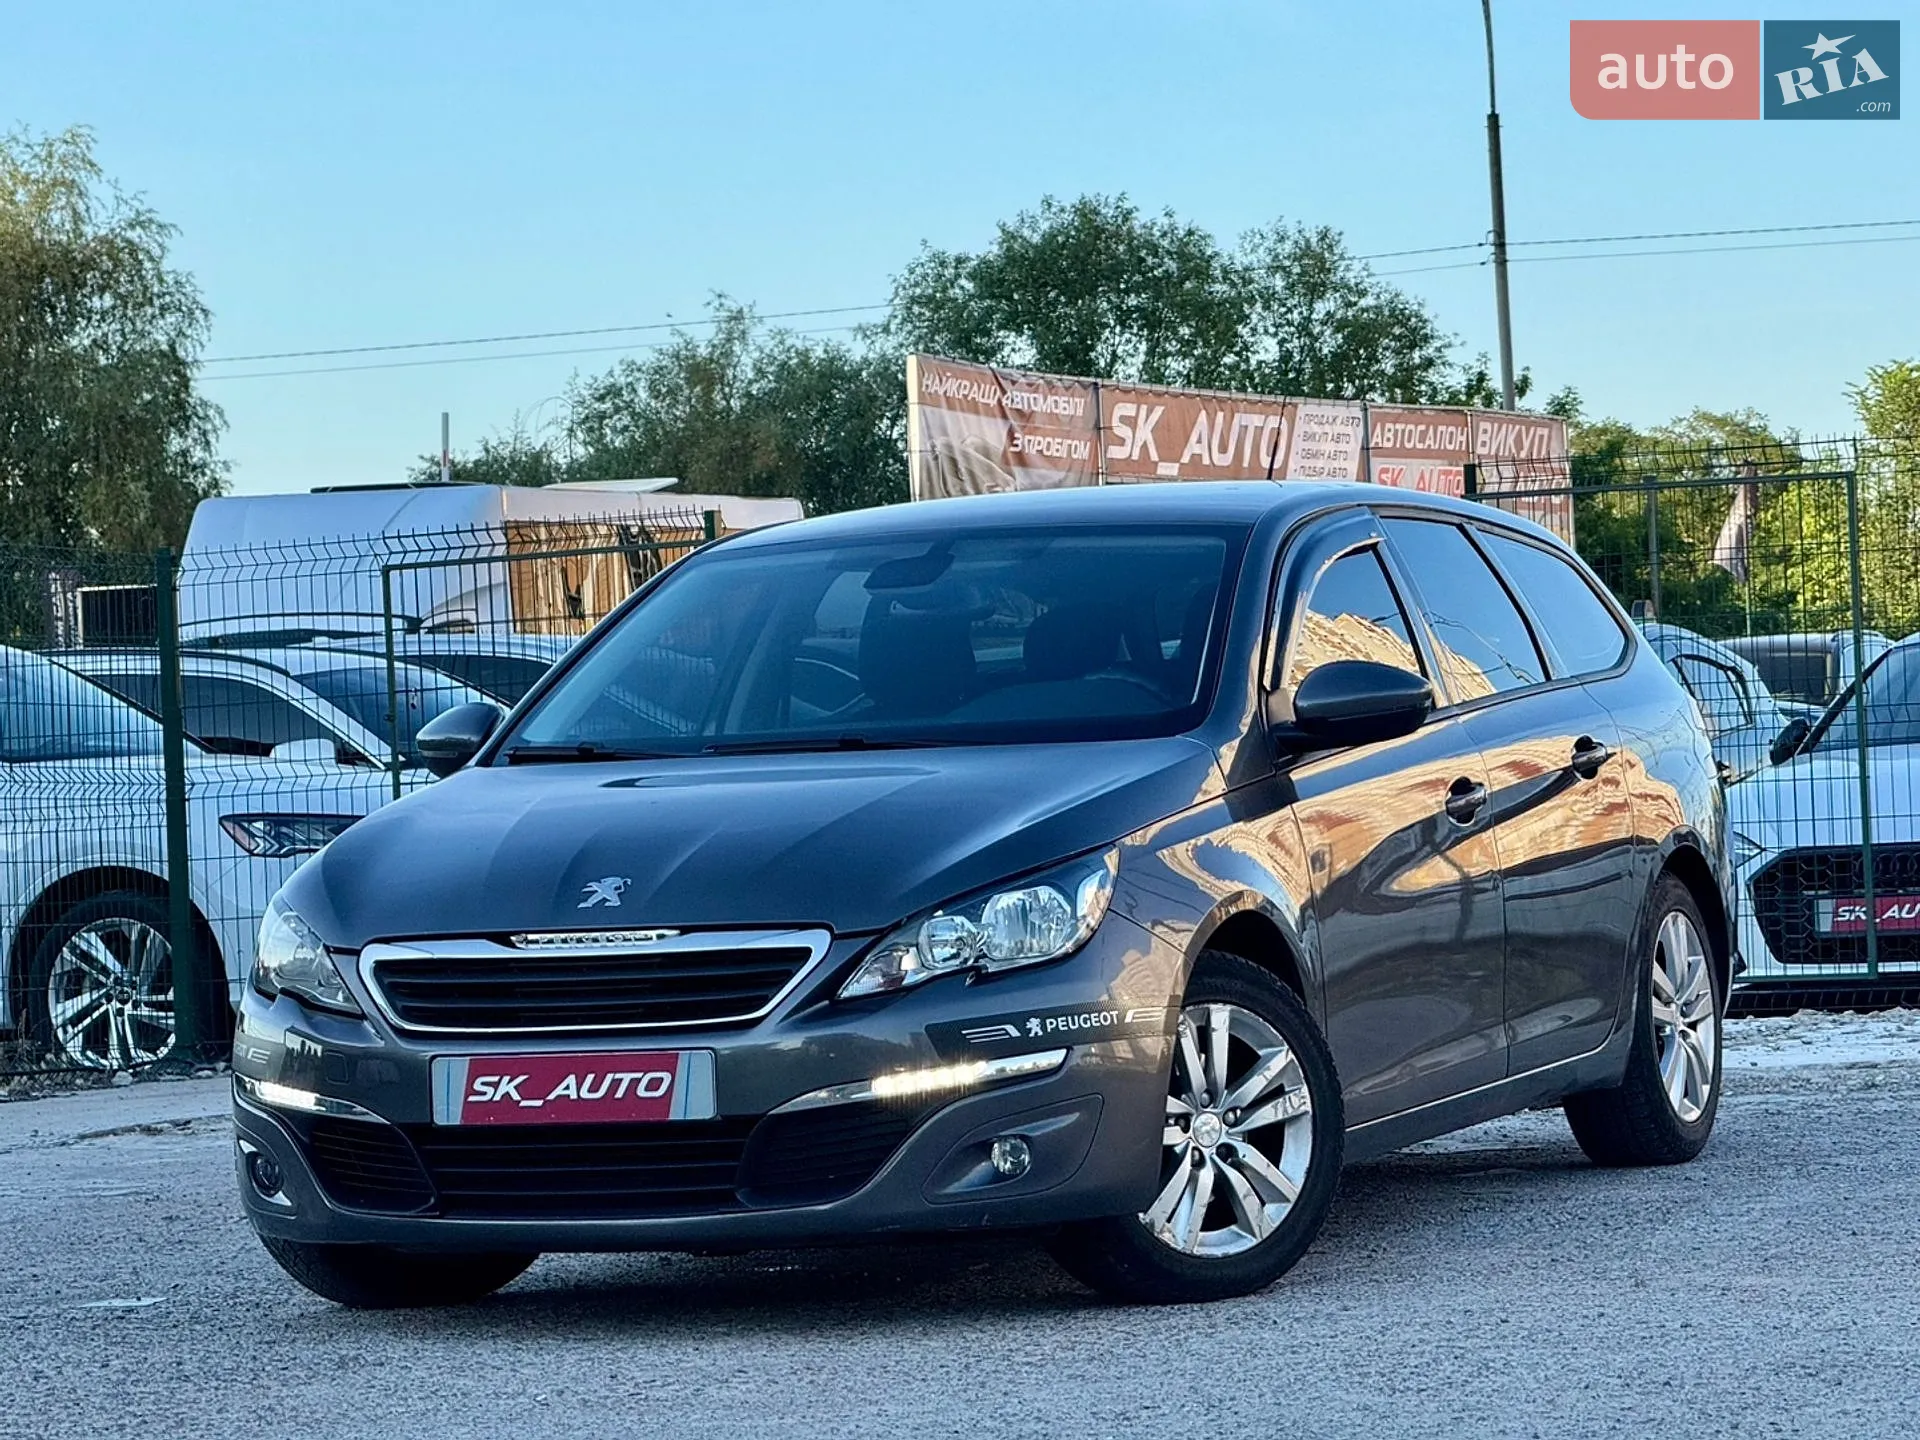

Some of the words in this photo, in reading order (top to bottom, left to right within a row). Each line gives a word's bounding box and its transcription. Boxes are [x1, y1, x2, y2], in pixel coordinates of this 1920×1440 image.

[1340, 416, 1361, 428] АВТО
[1024, 434, 1091, 460] ПРОБІГОМ
[1106, 402, 1289, 477] SK_AUTO
[1330, 433, 1351, 444] АВТО
[1370, 422, 1468, 451] АВТОСАЛОН
[1476, 421, 1550, 459] ВИКУП
[1327, 450, 1348, 461] АВТО
[1326, 467, 1348, 479] АВТО
[1045, 1010, 1119, 1033] PEUGEOT
[466, 1071, 673, 1107] SK_AUTO
